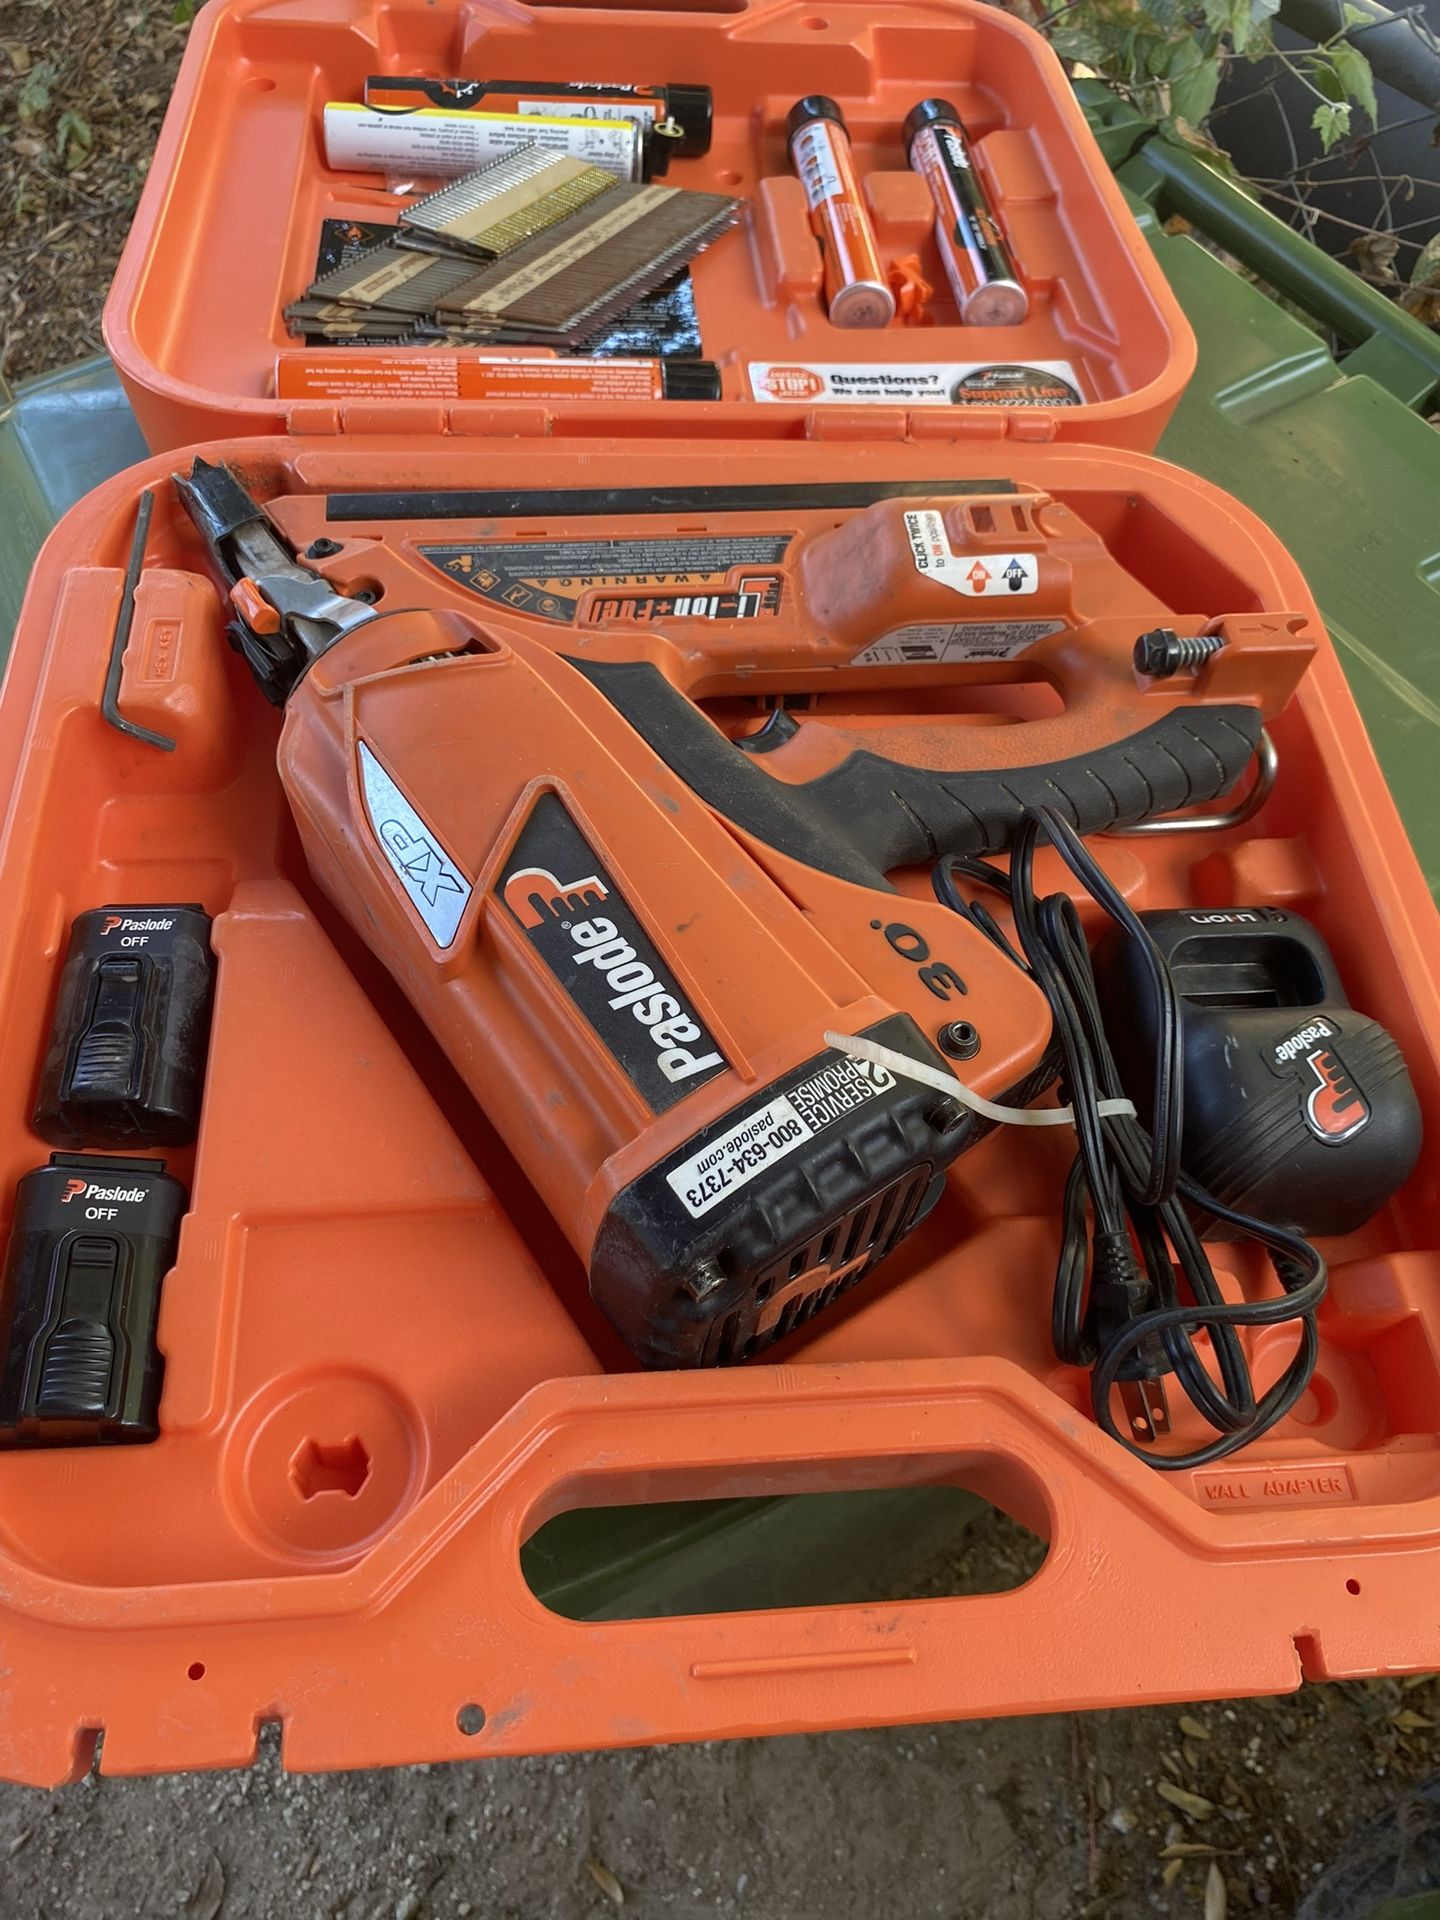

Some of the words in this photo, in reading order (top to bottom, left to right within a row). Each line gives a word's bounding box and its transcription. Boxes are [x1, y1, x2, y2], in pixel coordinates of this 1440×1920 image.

[830, 374, 939, 385] Questions?
[959, 385, 1029, 400] Support
[906, 514, 922, 541] TWICE
[914, 543, 929, 569] CLICK
[931, 544, 944, 557] ON
[559, 575, 690, 587] WARNING
[972, 569, 987, 580] ON
[1006, 568, 1024, 579] OFF
[379, 819, 465, 907] XP
[120, 917, 173, 932] Paslode
[120, 936, 149, 947] OFF
[570, 917, 725, 1083] Paslode
[1275, 1021, 1334, 1060] Paslode
[787, 1059, 858, 1110] PROMISE
[801, 1078, 874, 1131] SERVICE
[697, 1111, 774, 1176] paslode.com
[686, 1118, 803, 1208] 800-634-7373
[85, 1184, 146, 1203] Paslode
[85, 1206, 118, 1221] OFF
[1204, 1483, 1251, 1500] WALL
[1263, 1477, 1342, 1497] ADAPTER
